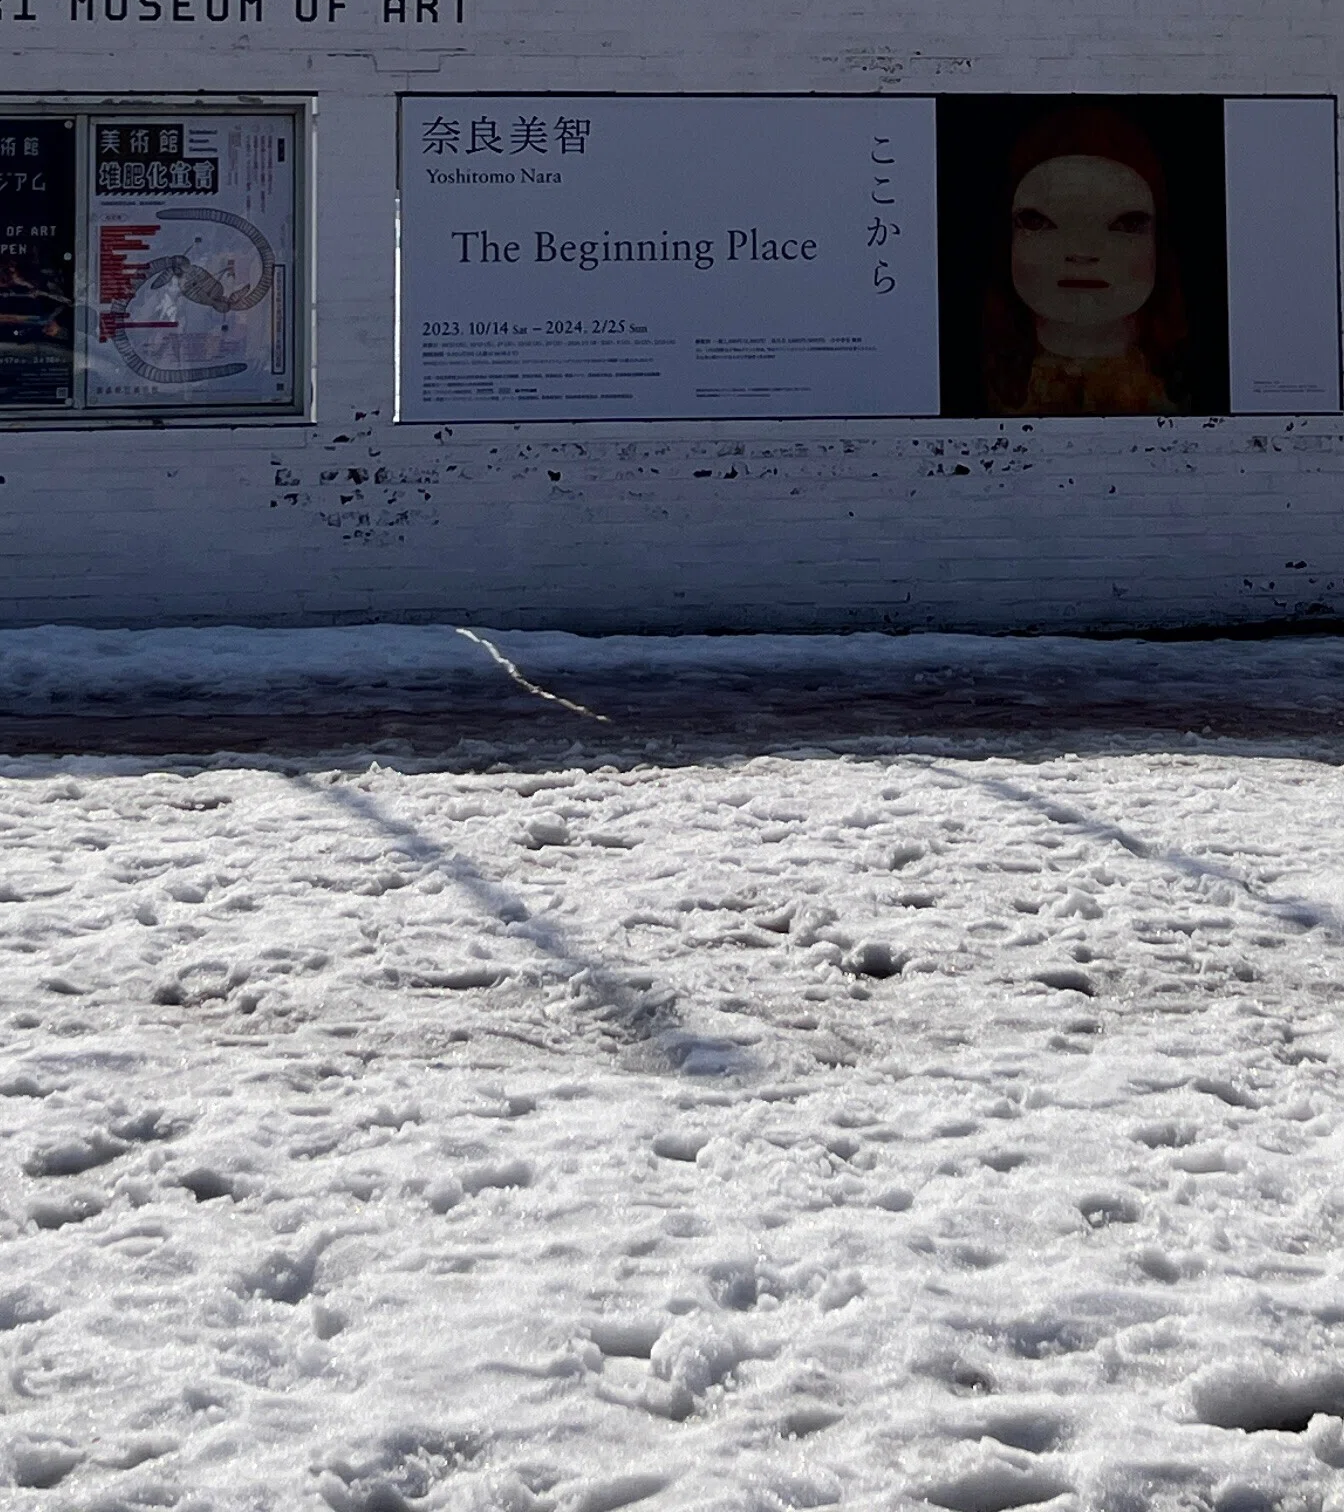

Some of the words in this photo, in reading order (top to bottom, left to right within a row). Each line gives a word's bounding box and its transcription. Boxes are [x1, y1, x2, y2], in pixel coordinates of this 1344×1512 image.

[99, 129, 179, 155] 美術館
[421, 115, 592, 156] 奈良美智
[426, 168, 516, 184] Yoshitomo
[520, 168, 563, 184] Nara
[866, 135, 902, 295] ここから
[6, 225, 24, 236] OF
[30, 225, 57, 236] ART
[451, 229, 522, 264] The
[533, 229, 716, 272] Beginning
[726, 228, 818, 262] Place
[468, 321, 509, 336] 10/14
[591, 319, 626, 334] 2/25
[628, 323, 649, 334] Sun
